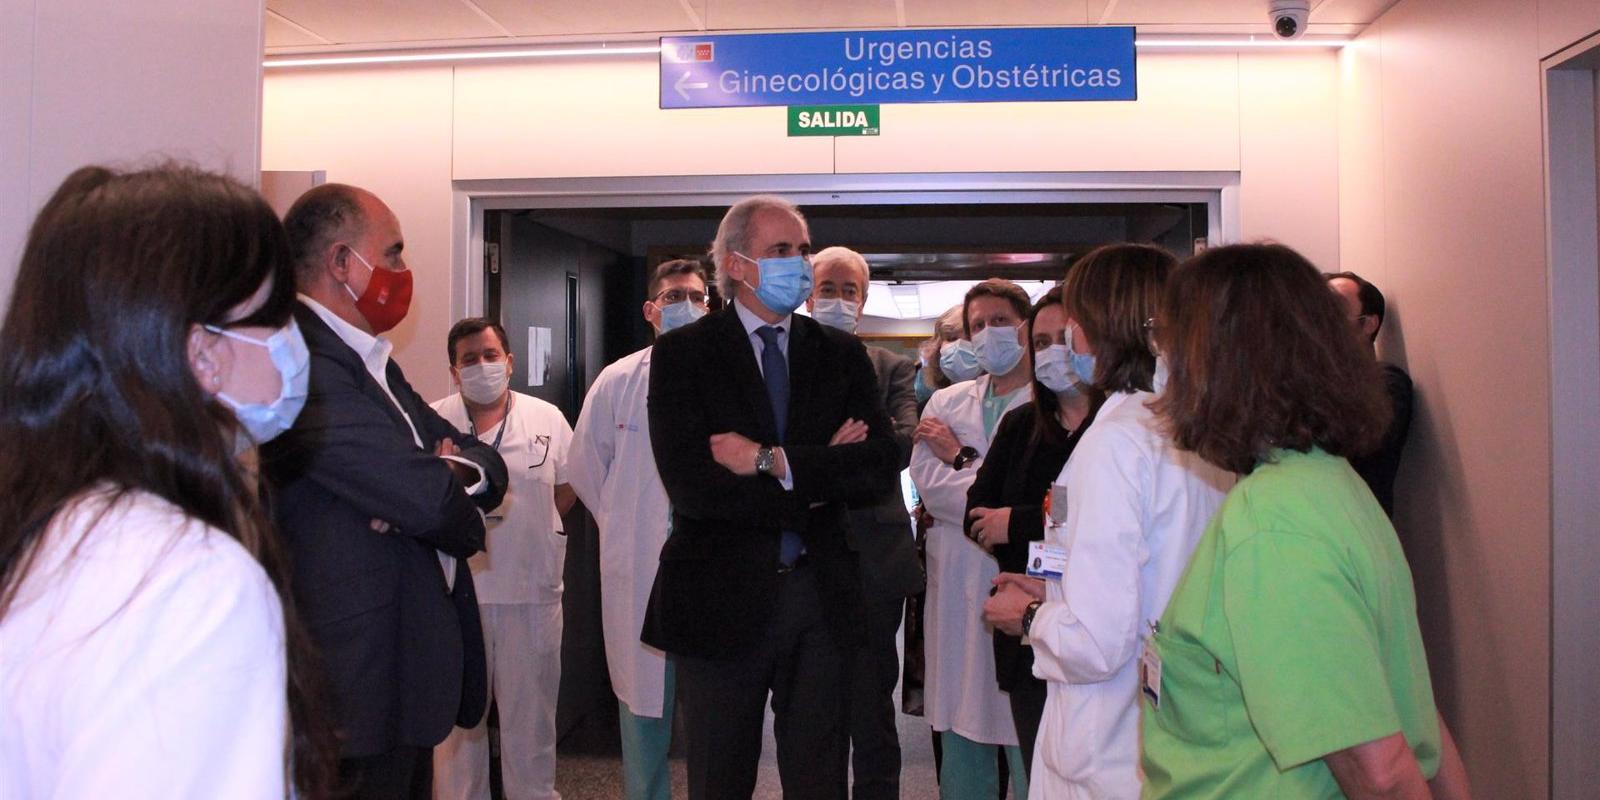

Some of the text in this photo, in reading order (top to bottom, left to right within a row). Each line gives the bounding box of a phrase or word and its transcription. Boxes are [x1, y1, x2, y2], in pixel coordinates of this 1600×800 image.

[844, 35, 993, 66] Urgencias
[719, 63, 1122, 97] Ginecológicas y Obstétricas
[798, 111, 869, 128] SALIDA
